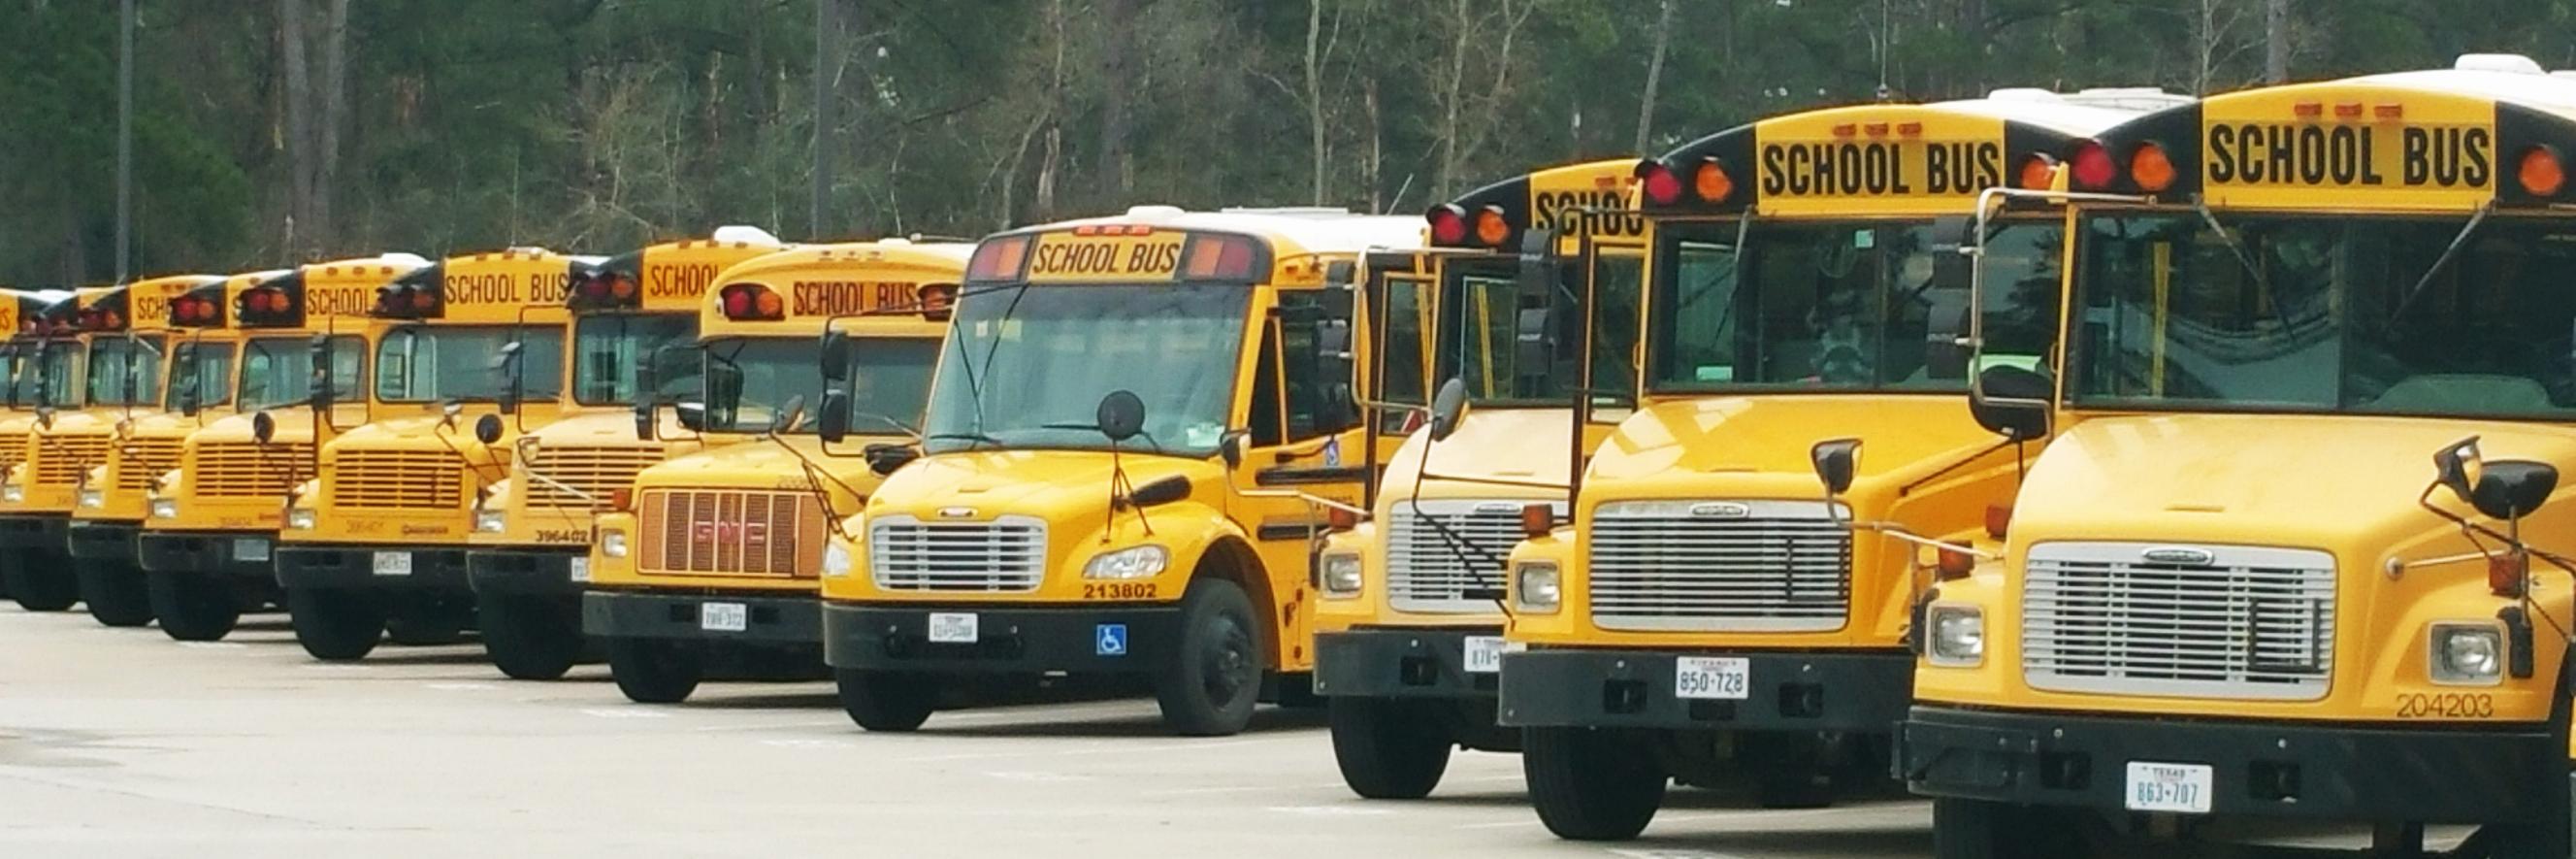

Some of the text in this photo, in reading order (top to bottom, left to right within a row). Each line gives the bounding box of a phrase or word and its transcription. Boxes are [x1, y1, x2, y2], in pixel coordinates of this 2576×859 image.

[1763, 142, 1999, 196] SCHOOL BUS
[2208, 124, 2490, 187] SCHOOL BUS
[1537, 191, 1645, 236] SCHOO
[1033, 243, 1181, 274] SCHOOL BUS
[445, 273, 570, 304] SCHOOL BUS
[794, 281, 864, 315] SCHOOL
[1083, 583, 1158, 599] 213802
[2397, 693, 2494, 718] 204203
